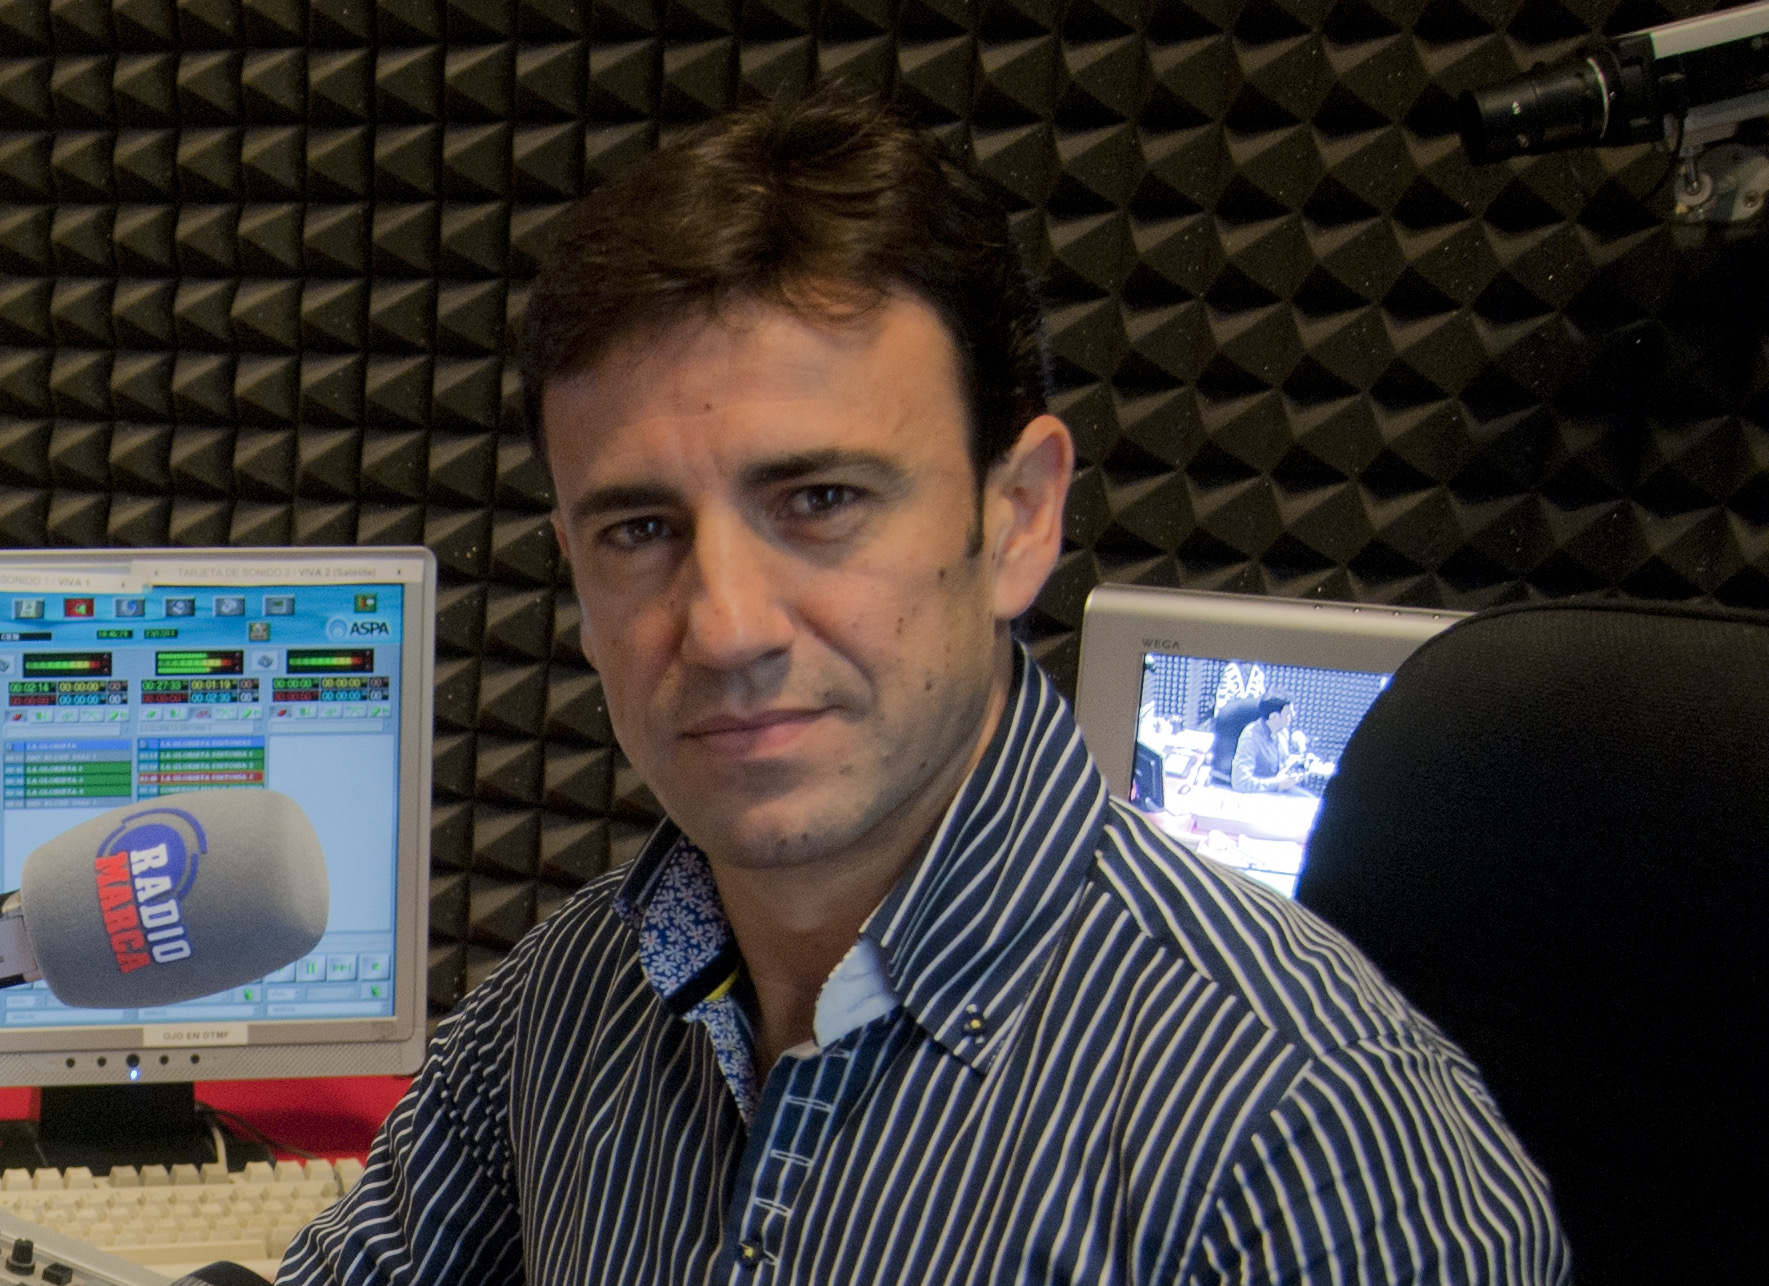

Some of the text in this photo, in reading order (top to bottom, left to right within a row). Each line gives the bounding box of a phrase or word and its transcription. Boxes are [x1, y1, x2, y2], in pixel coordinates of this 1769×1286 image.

[178, 568, 224, 578] TARJETA
[225, 568, 240, 577] DE
[242, 567, 282, 577] SONIDO
[298, 567, 322, 577] VIVA
[0, 575, 40, 586] SONIDO
[57, 577, 82, 587] VIVA
[350, 621, 390, 636] ASPA
[1142, 638, 1181, 650] WEGA
[95, 842, 193, 975] RADIO MARCA
[163, 1030, 231, 1041] OJO EN DTMF
